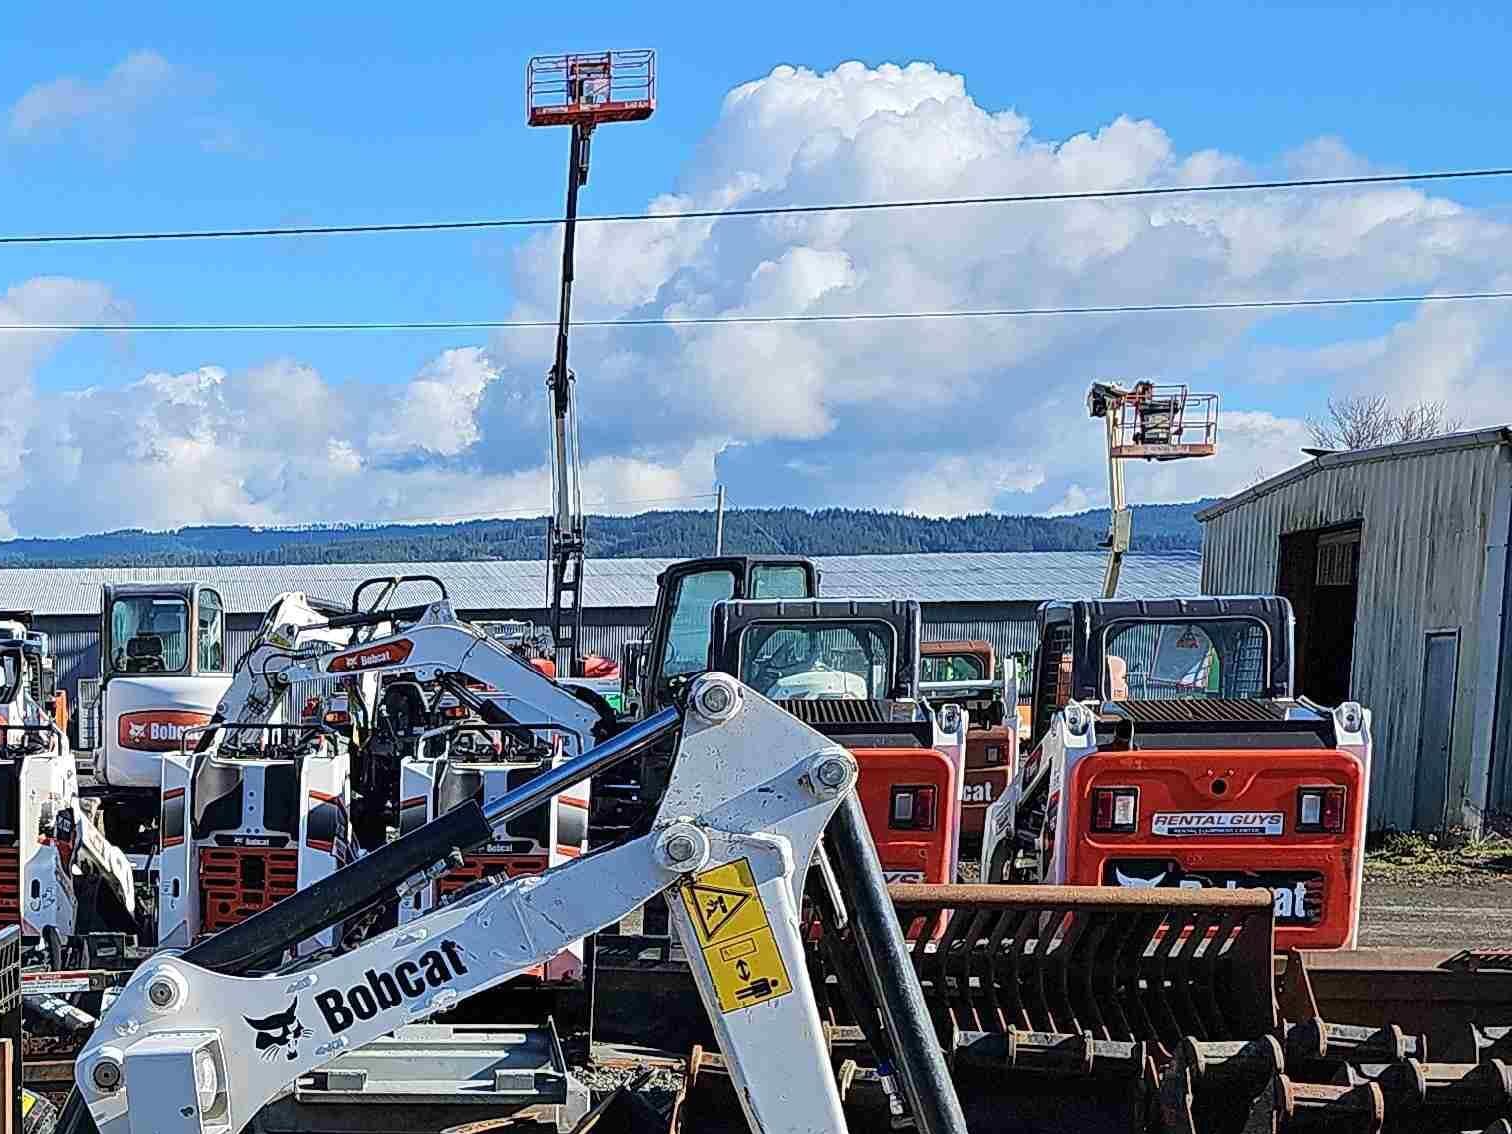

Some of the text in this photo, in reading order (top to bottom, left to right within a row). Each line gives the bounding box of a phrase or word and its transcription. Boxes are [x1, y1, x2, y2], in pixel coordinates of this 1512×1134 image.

[360, 650, 391, 666] Bobcat
[963, 782, 993, 802] cat
[1154, 814, 1281, 826] RENTAL GUYS
[314, 939, 468, 1035] Bobcat
